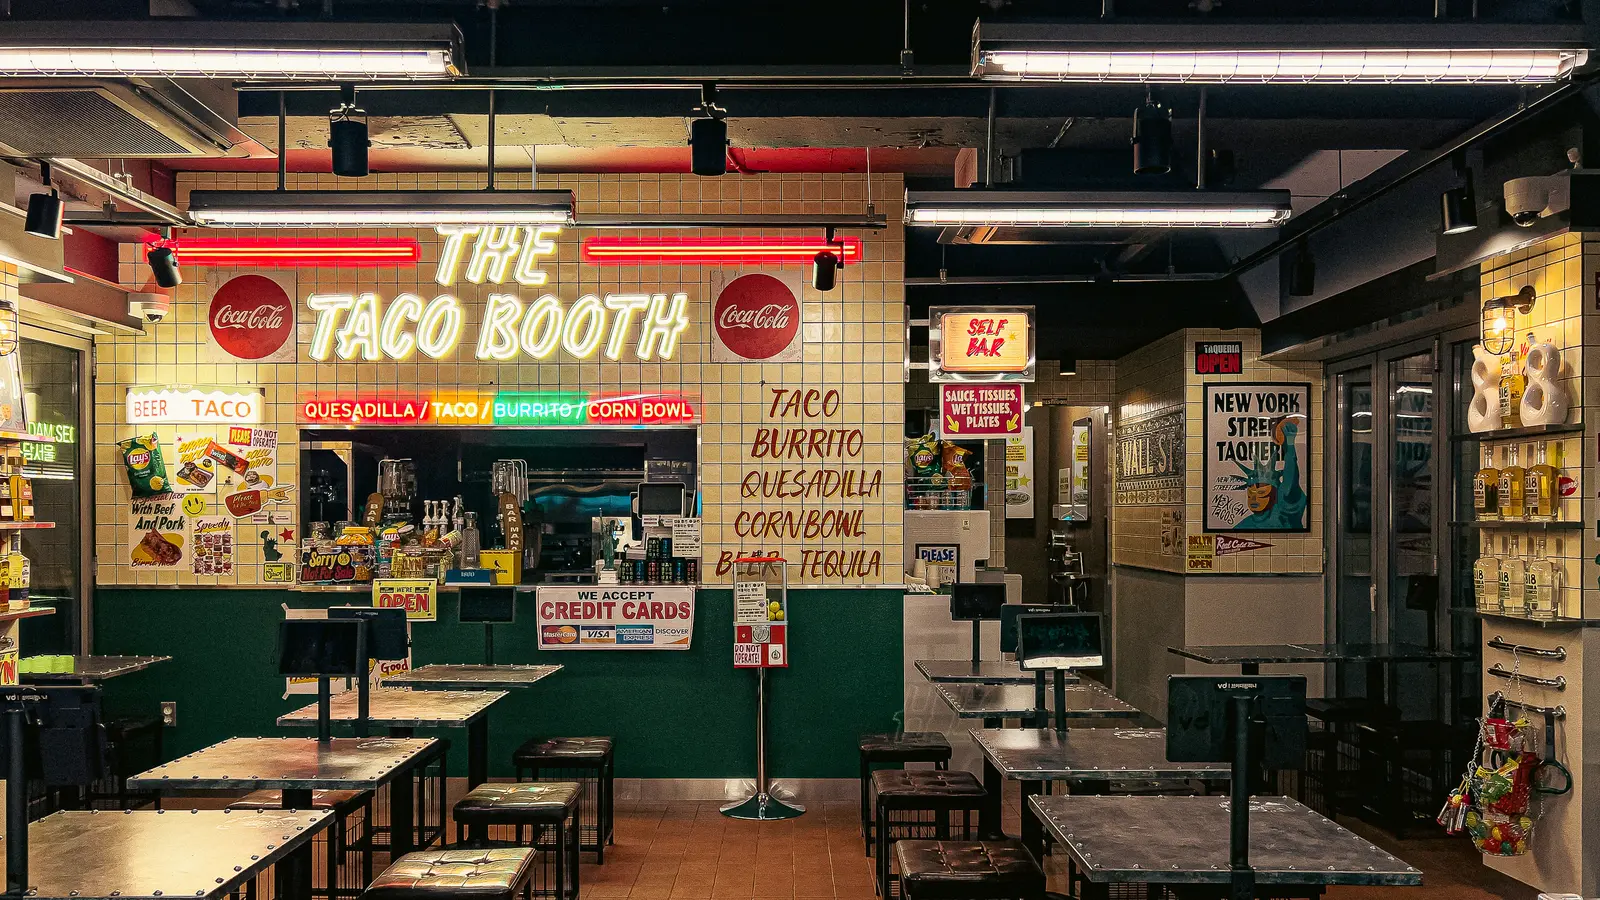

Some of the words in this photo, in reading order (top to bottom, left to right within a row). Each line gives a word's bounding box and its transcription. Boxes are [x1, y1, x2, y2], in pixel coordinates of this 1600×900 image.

[435, 225, 562, 285] THE
[214, 304, 286, 329] Coca-Cola
[719, 304, 793, 329] Coca-Cola
[307, 292, 463, 361] TACO
[475, 292, 689, 361] BOOTH
[967, 319, 1008, 336] SELF
[966, 338, 1005, 357] BAR
[1204, 345, 1240, 354] TAQUERIA
[1198, 354, 1239, 373] OPEN
[769, 388, 840, 418] TACO
[945, 390, 977, 403] SAUCE,
[979, 390, 1018, 403] TISSUES,
[1214, 393, 1252, 413] NEW
[1256, 393, 1299, 413] YORK
[134, 400, 167, 417] BEER
[191, 399, 251, 418] TACO
[305, 402, 415, 418] QUESADILLA
[432, 402, 478, 417] TACO
[494, 402, 572, 418] BURRITO
[589, 403, 636, 418] CORN
[642, 403, 692, 418] BOWL
[951, 403, 973, 415] WET
[973, 403, 1013, 416] TISSUES,
[966, 416, 1000, 428] PLATES
[1228, 417, 1275, 437] STREE
[231, 428, 251, 444] PLEASE
[253, 429, 263, 437] DO
[264, 430, 277, 439] NOT
[20, 441, 55, 462] 담서울
[252, 437, 276, 449] OPERATE!
[751, 428, 864, 459] BURRITO
[1216, 441, 1285, 461] TAQUERI
[1121, 438, 1153, 477] WALL
[1158, 437, 1173, 473] ST
[741, 469, 882, 498] QUESADILLA
[132, 503, 154, 514] With
[154, 502, 175, 514] Beef
[367, 503, 379, 522] BAR
[505, 503, 517, 522] BAR
[135, 516, 159, 530] And
[158, 516, 185, 530] Pork
[195, 518, 230, 532] Speedy
[734, 510, 804, 539] CORN
[803, 510, 867, 539] BOWL
[309, 552, 338, 569] Sorry
[800, 549, 882, 578] TEQUILA
[922, 549, 954, 562] PLEASE
[1189, 559, 1213, 568] OPEN
[303, 567, 320, 580] Not
[320, 567, 333, 580] For
[334, 566, 353, 580] Sale
[379, 593, 430, 612] OPEN
[578, 591, 598, 600] WE
[602, 591, 654, 600] ACCEPT
[541, 602, 616, 620] CREDIT
[622, 602, 691, 620] CARDS
[587, 630, 610, 638] VISA
[734, 645, 744, 653] DO
[745, 645, 760, 653] NOT
[381, 658, 409, 675] Good
[735, 653, 760, 664] OPERATE!
